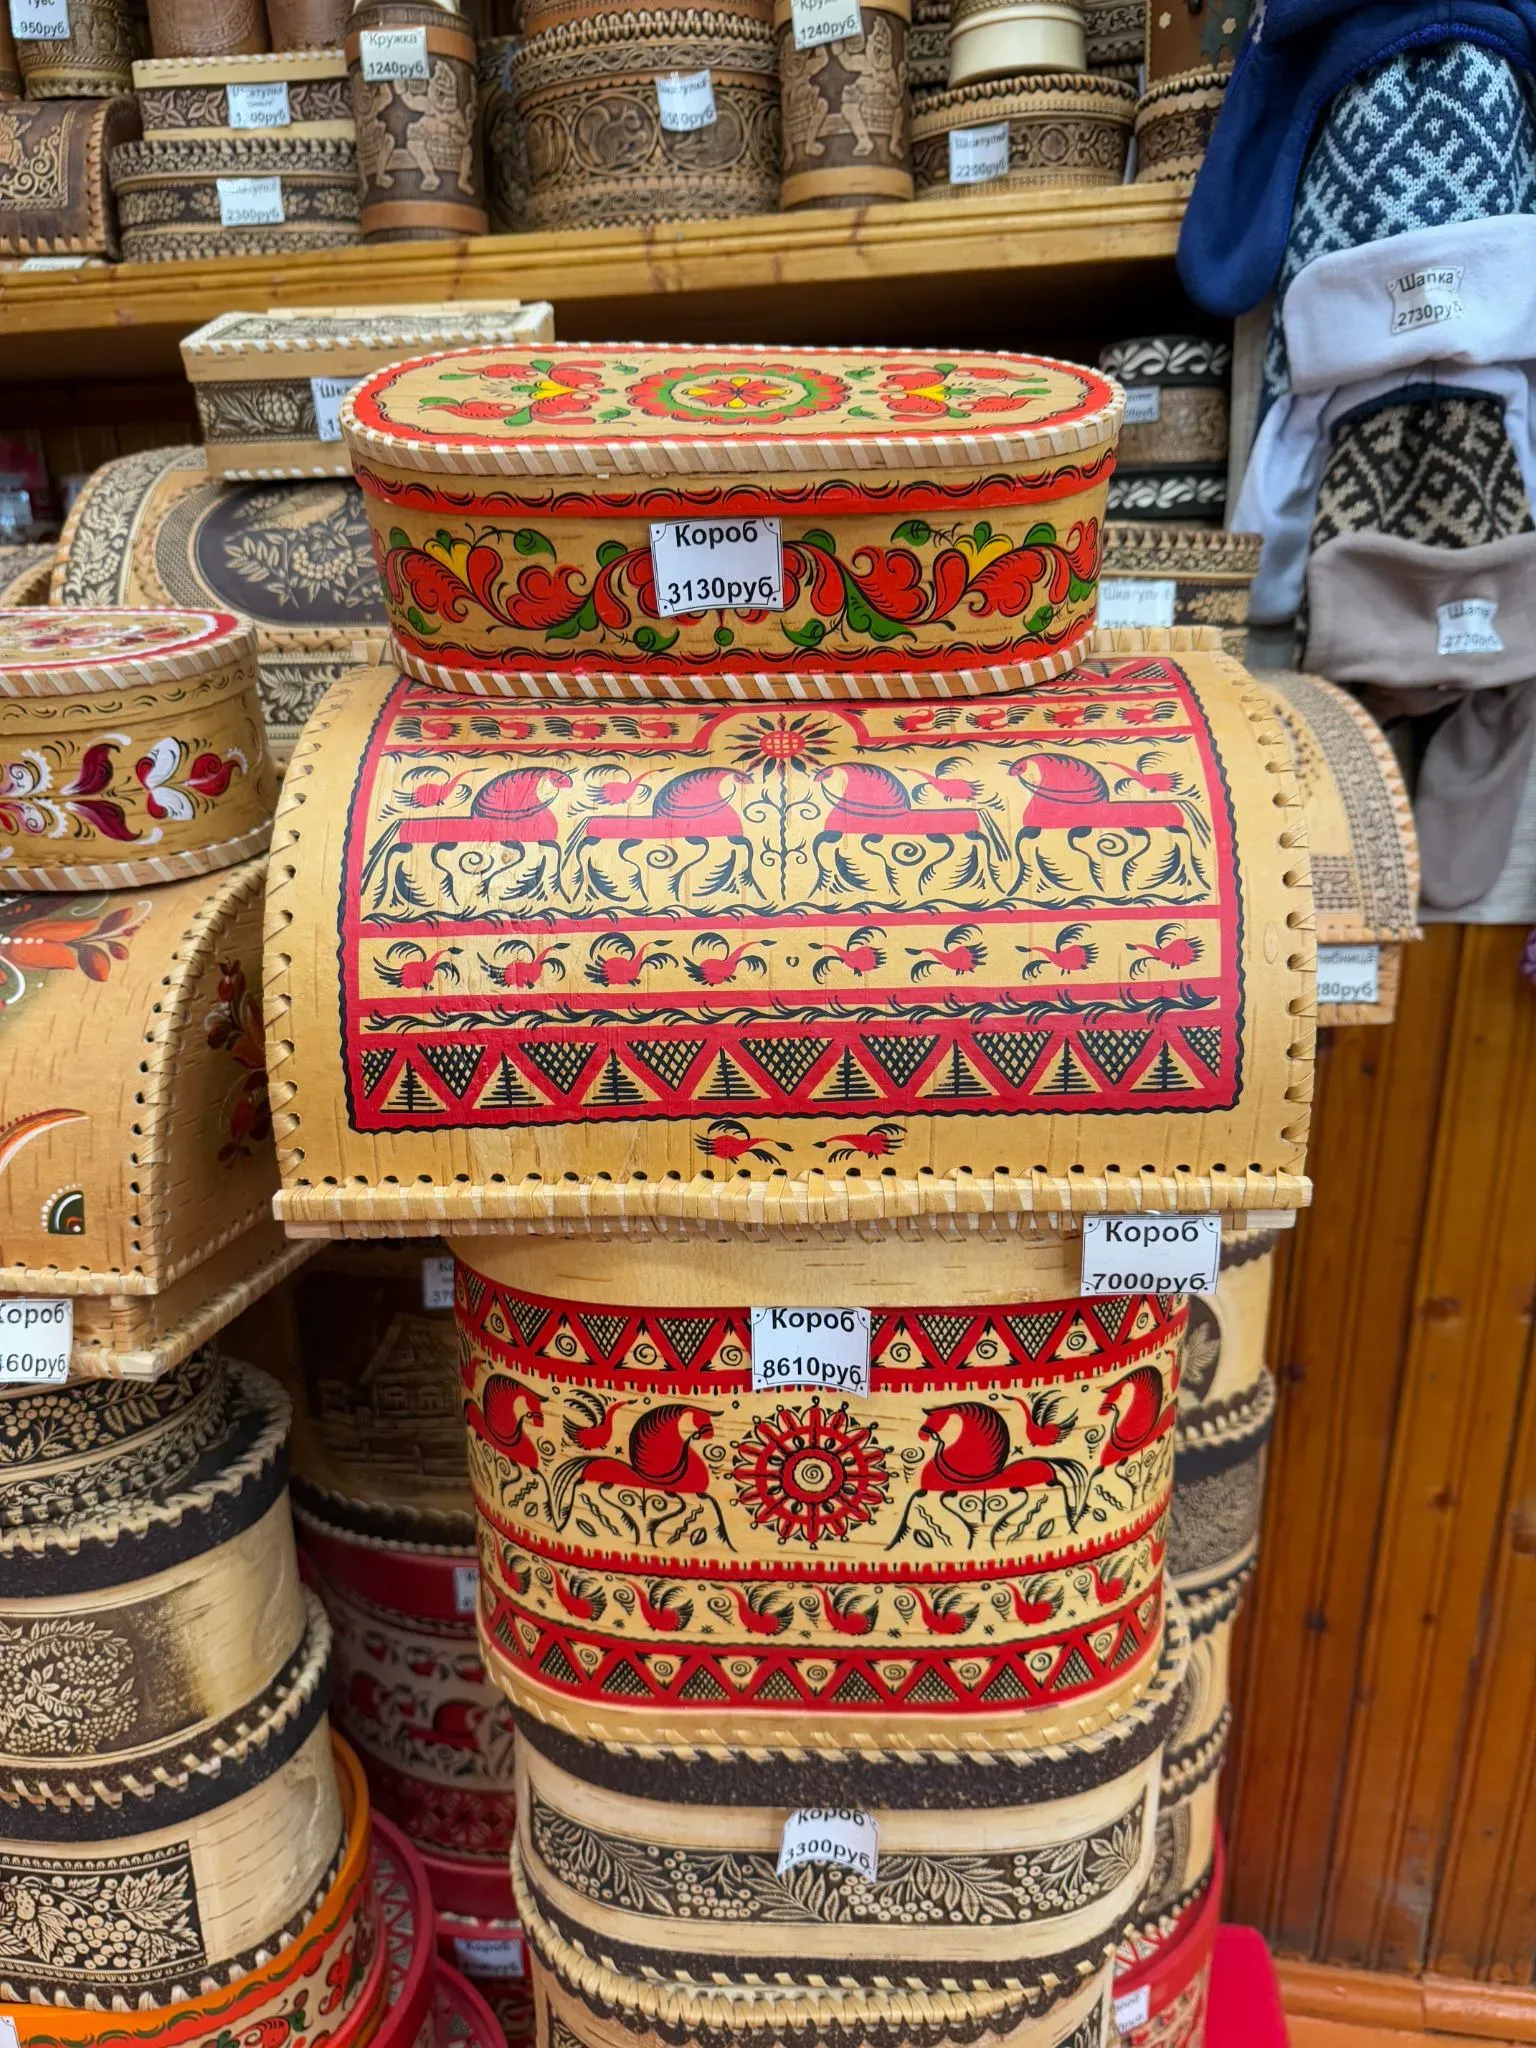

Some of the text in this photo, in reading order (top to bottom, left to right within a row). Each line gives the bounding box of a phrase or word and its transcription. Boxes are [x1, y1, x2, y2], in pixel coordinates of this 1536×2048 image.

[20, 21, 65, 37] 950руб
[801, 15, 855, 40] 1240руб
[369, 60, 424, 77] 1240руб
[1399, 271, 1454, 292] Шапка
[1398, 301, 1463, 327] 2730руб
[675, 520, 758, 550] Короб
[667, 575, 773, 605] 3130руб
[1105, 1219, 1199, 1248] Короб
[1092, 1272, 1206, 1294] 7000руб
[771, 1308, 855, 1333] Короб
[763, 1356, 861, 1385] 8610руб
